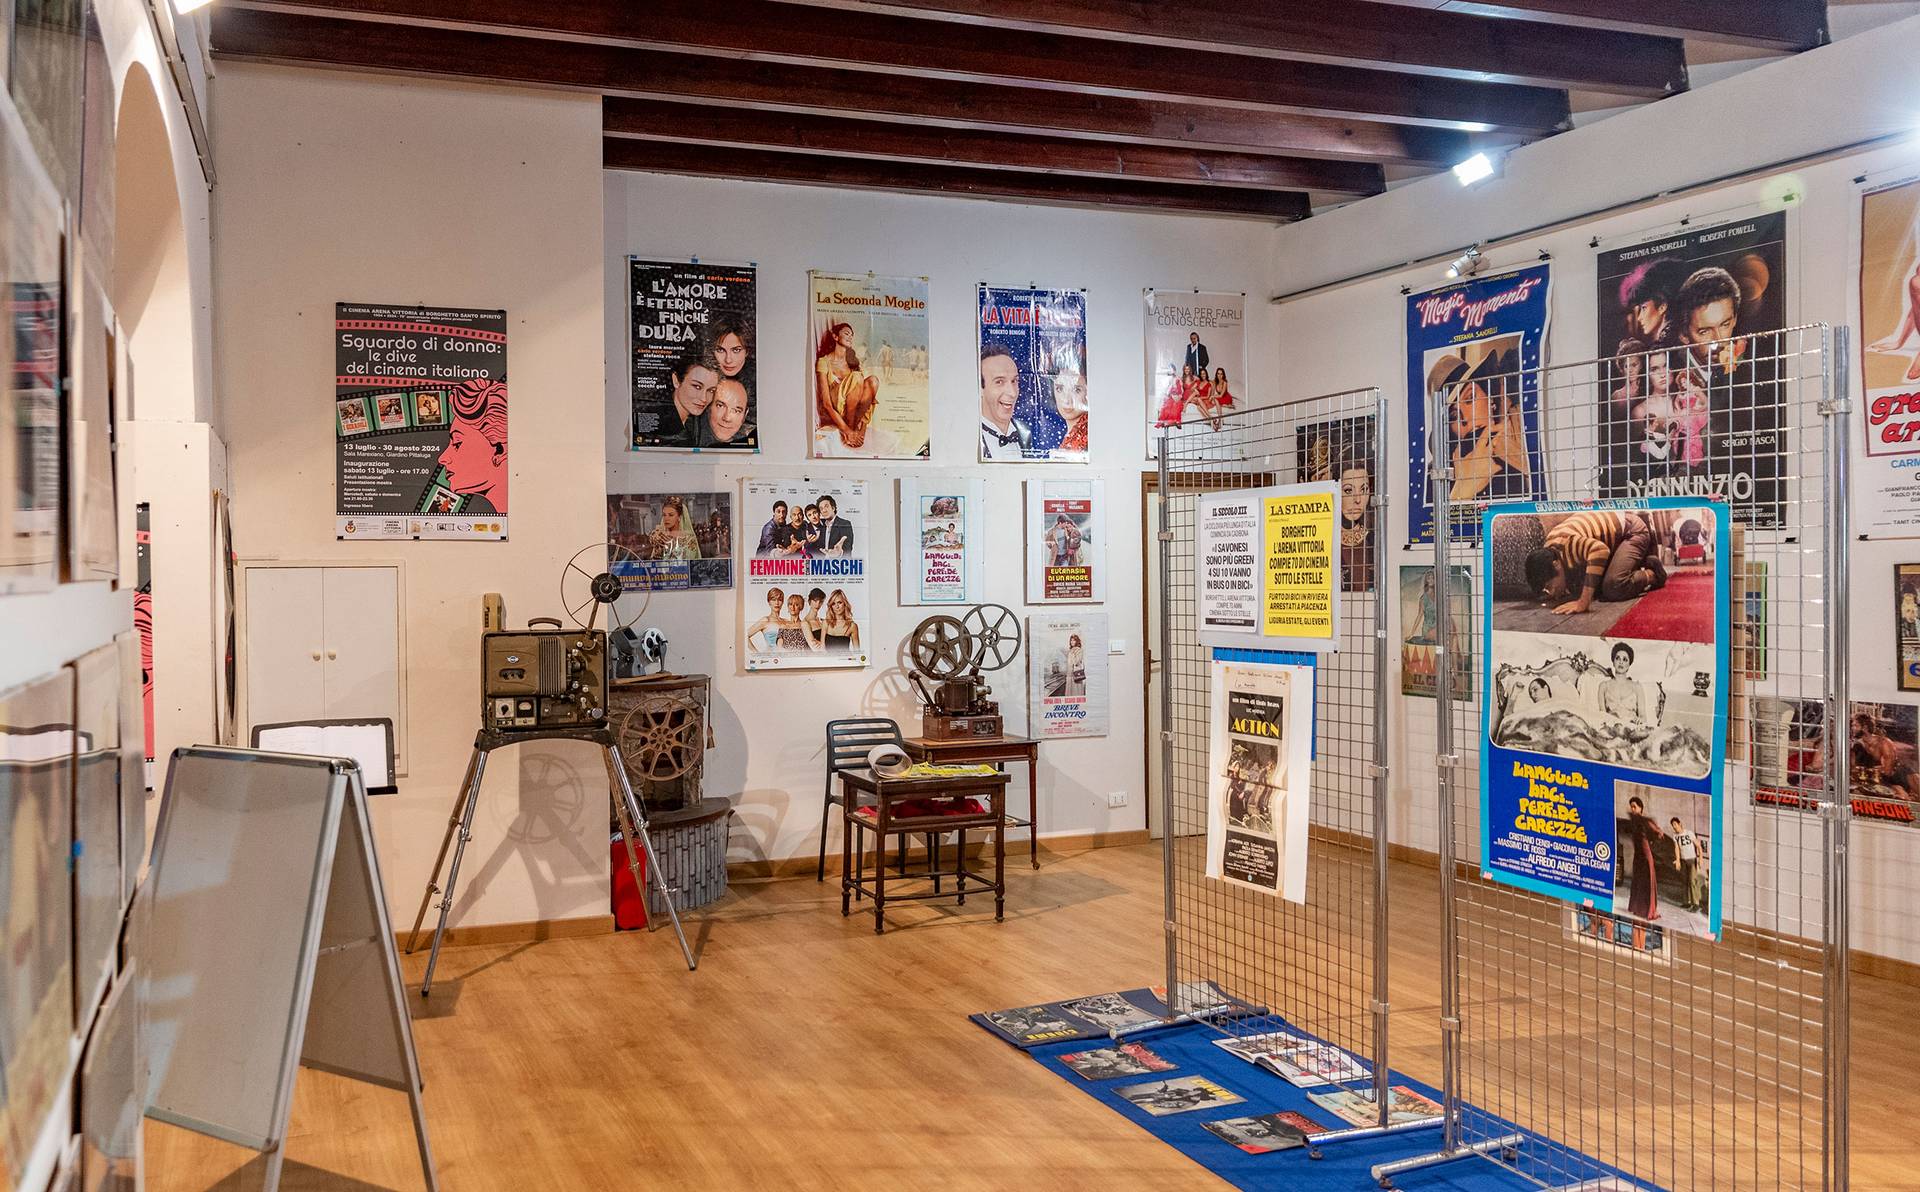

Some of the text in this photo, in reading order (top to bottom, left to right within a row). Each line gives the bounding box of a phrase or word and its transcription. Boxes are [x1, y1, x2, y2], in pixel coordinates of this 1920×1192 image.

[1619, 249, 1650, 262] STEFANIA
[1651, 240, 1686, 254] SANDRELLI
[1700, 230, 1726, 244] ROBERT
[1728, 224, 1756, 237] POWELL
[652, 279, 727, 300] L'AMORE
[636, 291, 703, 310] È ETERNO
[817, 292, 925, 310] La Seconda Moglie
[983, 307, 998, 324] LA
[1001, 308, 1030, 325] VITA
[1148, 306, 1242, 320] LA CENA PER FARLI
[1158, 316, 1217, 328] CONOSCERE
[639, 324, 696, 342] DURA
[342, 334, 502, 354] Sguardo di donna:
[369, 350, 417, 363] le dive
[346, 362, 489, 378] del cinema italiano
[1721, 438, 1747, 448] SERGIO
[1270, 502, 1330, 516] LA STAMPA
[1281, 525, 1316, 538] BORGHETTO
[1218, 542, 1248, 552] SAVONESI
[1274, 541, 1324, 554] L'ARENA VITTORIA
[1206, 553, 1254, 565] SONO PIÙ GREEN
[1270, 556, 1329, 569] COMPIE 70 DI CINEMA
[1208, 568, 1251, 577] 4 SU 10 VANNO
[1274, 572, 1323, 584] SOTTO LE STELLE
[1207, 580, 1212, 589] IN
[1214, 580, 1224, 589] BUS
[1225, 580, 1229, 589] O
[1231, 580, 1236, 589] IN
[1044, 711, 1087, 719] INCONTRO
[1231, 717, 1280, 738] ACTION
[1850, 799, 1915, 822] ANSONE
[1515, 815, 1587, 843] CAREZZE
[1498, 838, 1546, 855] MASSIMO DE ROSSI
[1675, 835, 1692, 846] YES
[1552, 841, 1577, 854] GIACOMO
[1578, 847, 1594, 858] RIZZO
[1528, 854, 1556, 869] ALFREDO
[1556, 860, 1581, 875] ANGELI
[1575, 856, 1610, 871] ELISA CEGANI
